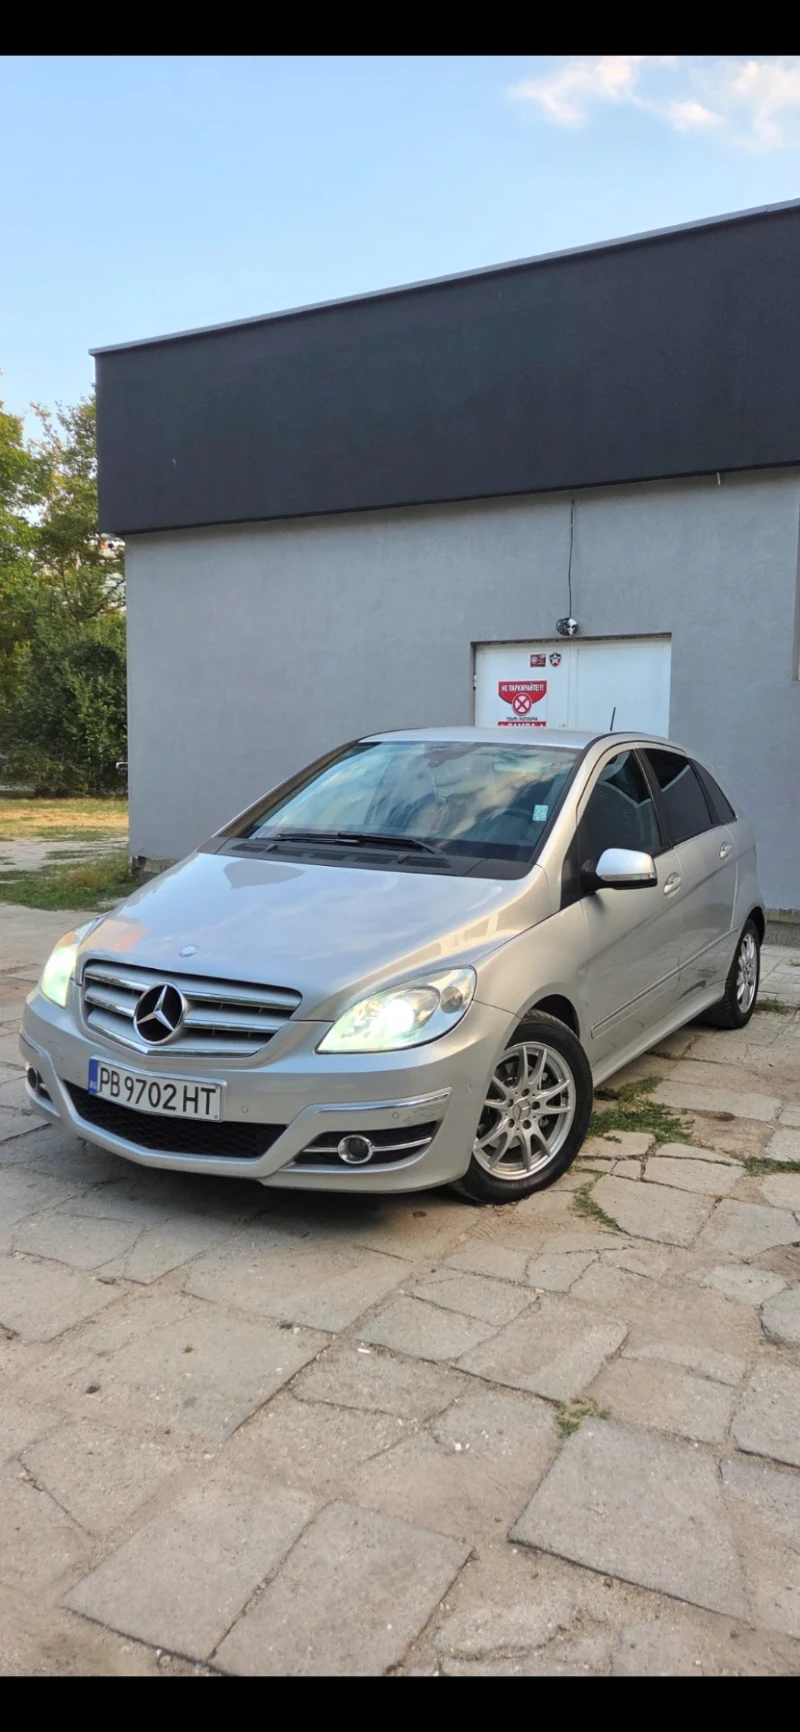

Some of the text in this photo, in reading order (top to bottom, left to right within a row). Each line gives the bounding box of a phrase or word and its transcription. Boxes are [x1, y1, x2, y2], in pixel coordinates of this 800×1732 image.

[100, 1067, 216, 1115] PB 9702 HT
